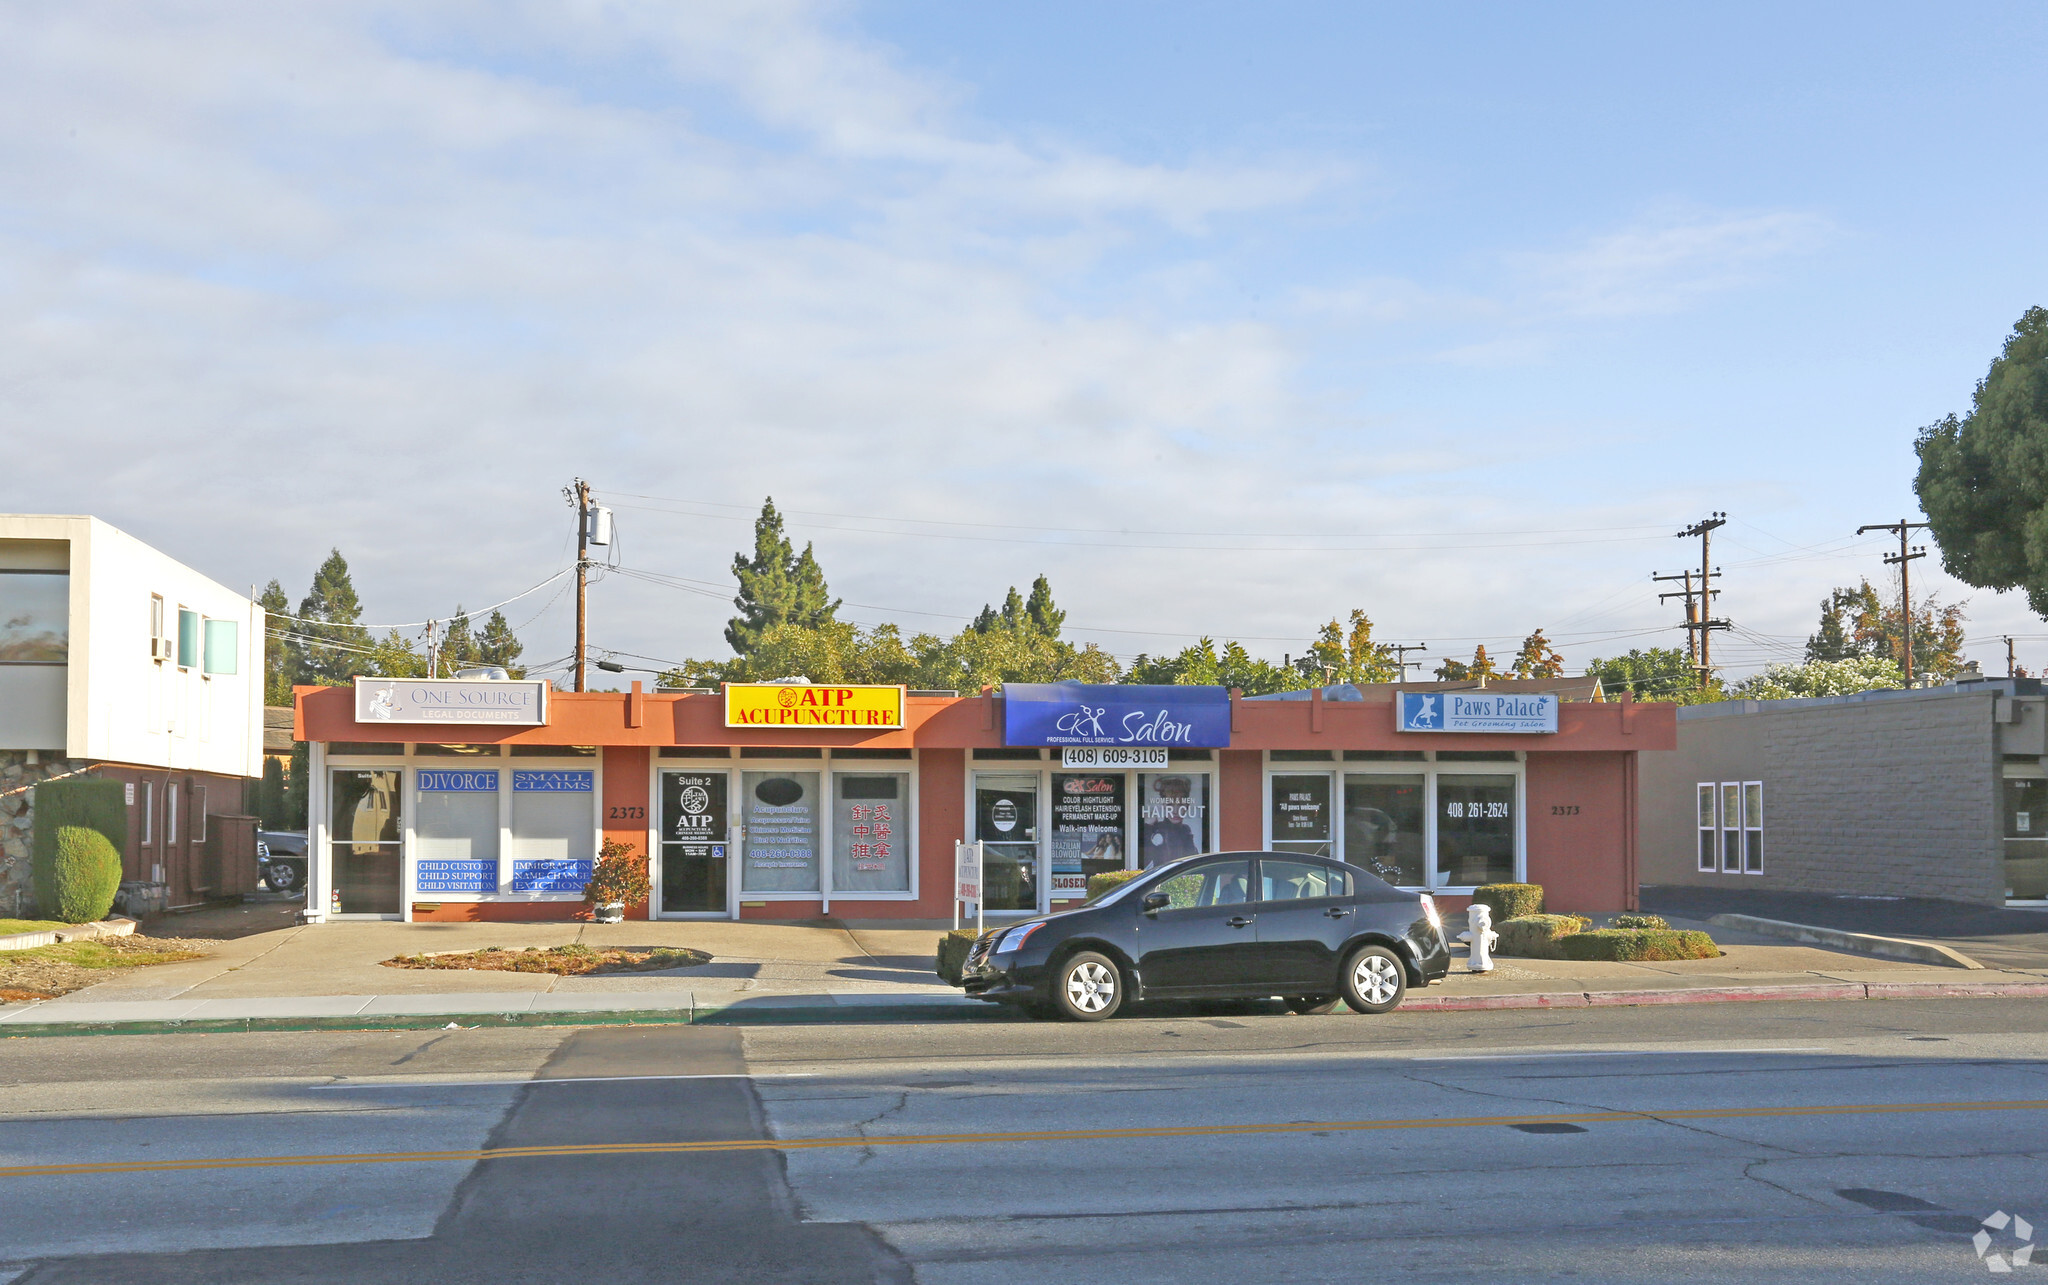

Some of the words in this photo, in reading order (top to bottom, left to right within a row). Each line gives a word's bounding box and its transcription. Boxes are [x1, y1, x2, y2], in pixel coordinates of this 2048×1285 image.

[411, 688, 453, 705] ONE
[459, 688, 532, 706] SOURCE
[800, 688, 854, 707] ATP
[1454, 696, 1491, 716] Paws
[1496, 697, 1544, 717] Palace
[422, 710, 454, 719] LEGAL
[458, 710, 520, 720] DOCUMENTS
[736, 708, 894, 726] ACUPUNCTURE
[1118, 709, 1192, 743] Salon
[1453, 720, 1467, 728] Pet
[1471, 720, 1516, 730] Grooming
[1046, 736, 1082, 744] PROFESSIONAL
[1082, 736, 1094, 744] FULL
[1064, 748, 1098, 766] (408)
[1102, 748, 1166, 765] 609-3105
[419, 773, 497, 790] DIVORCE
[515, 773, 590, 782] SMALL
[678, 776, 703, 786] Suite
[704, 777, 712, 786] 2
[515, 781, 591, 790] CLAIMS
[1062, 796, 1081, 804] COLOR
[609, 806, 645, 819] 2373
[753, 805, 809, 816] Acupuncture
[1092, 804, 1122, 813] EXTENSION
[1141, 805, 1175, 819] HAIR
[1177, 805, 1206, 819] CUT
[1447, 802, 1463, 818] 408
[1467, 802, 1508, 818] 261-2624
[1551, 806, 1581, 816] 2373
[676, 815, 714, 828] ATP
[1062, 813, 1095, 821] PERMANENT
[1095, 813, 1118, 821] MAKE-UP
[1059, 824, 1088, 833] Walk-ins
[1088, 824, 1118, 833] Welcome
[749, 849, 813, 859] 408-260-0388
[418, 862, 449, 871] CHILD
[450, 862, 495, 871] CUSTODY
[515, 861, 590, 871] IMMIGRATION
[418, 872, 450, 881] CHILD
[451, 872, 496, 881] SUPPORT
[514, 871, 545, 880] NAME
[546, 871, 590, 880] CHANGE
[418, 881, 446, 890] CHILD
[447, 881, 495, 890] VISITATION
